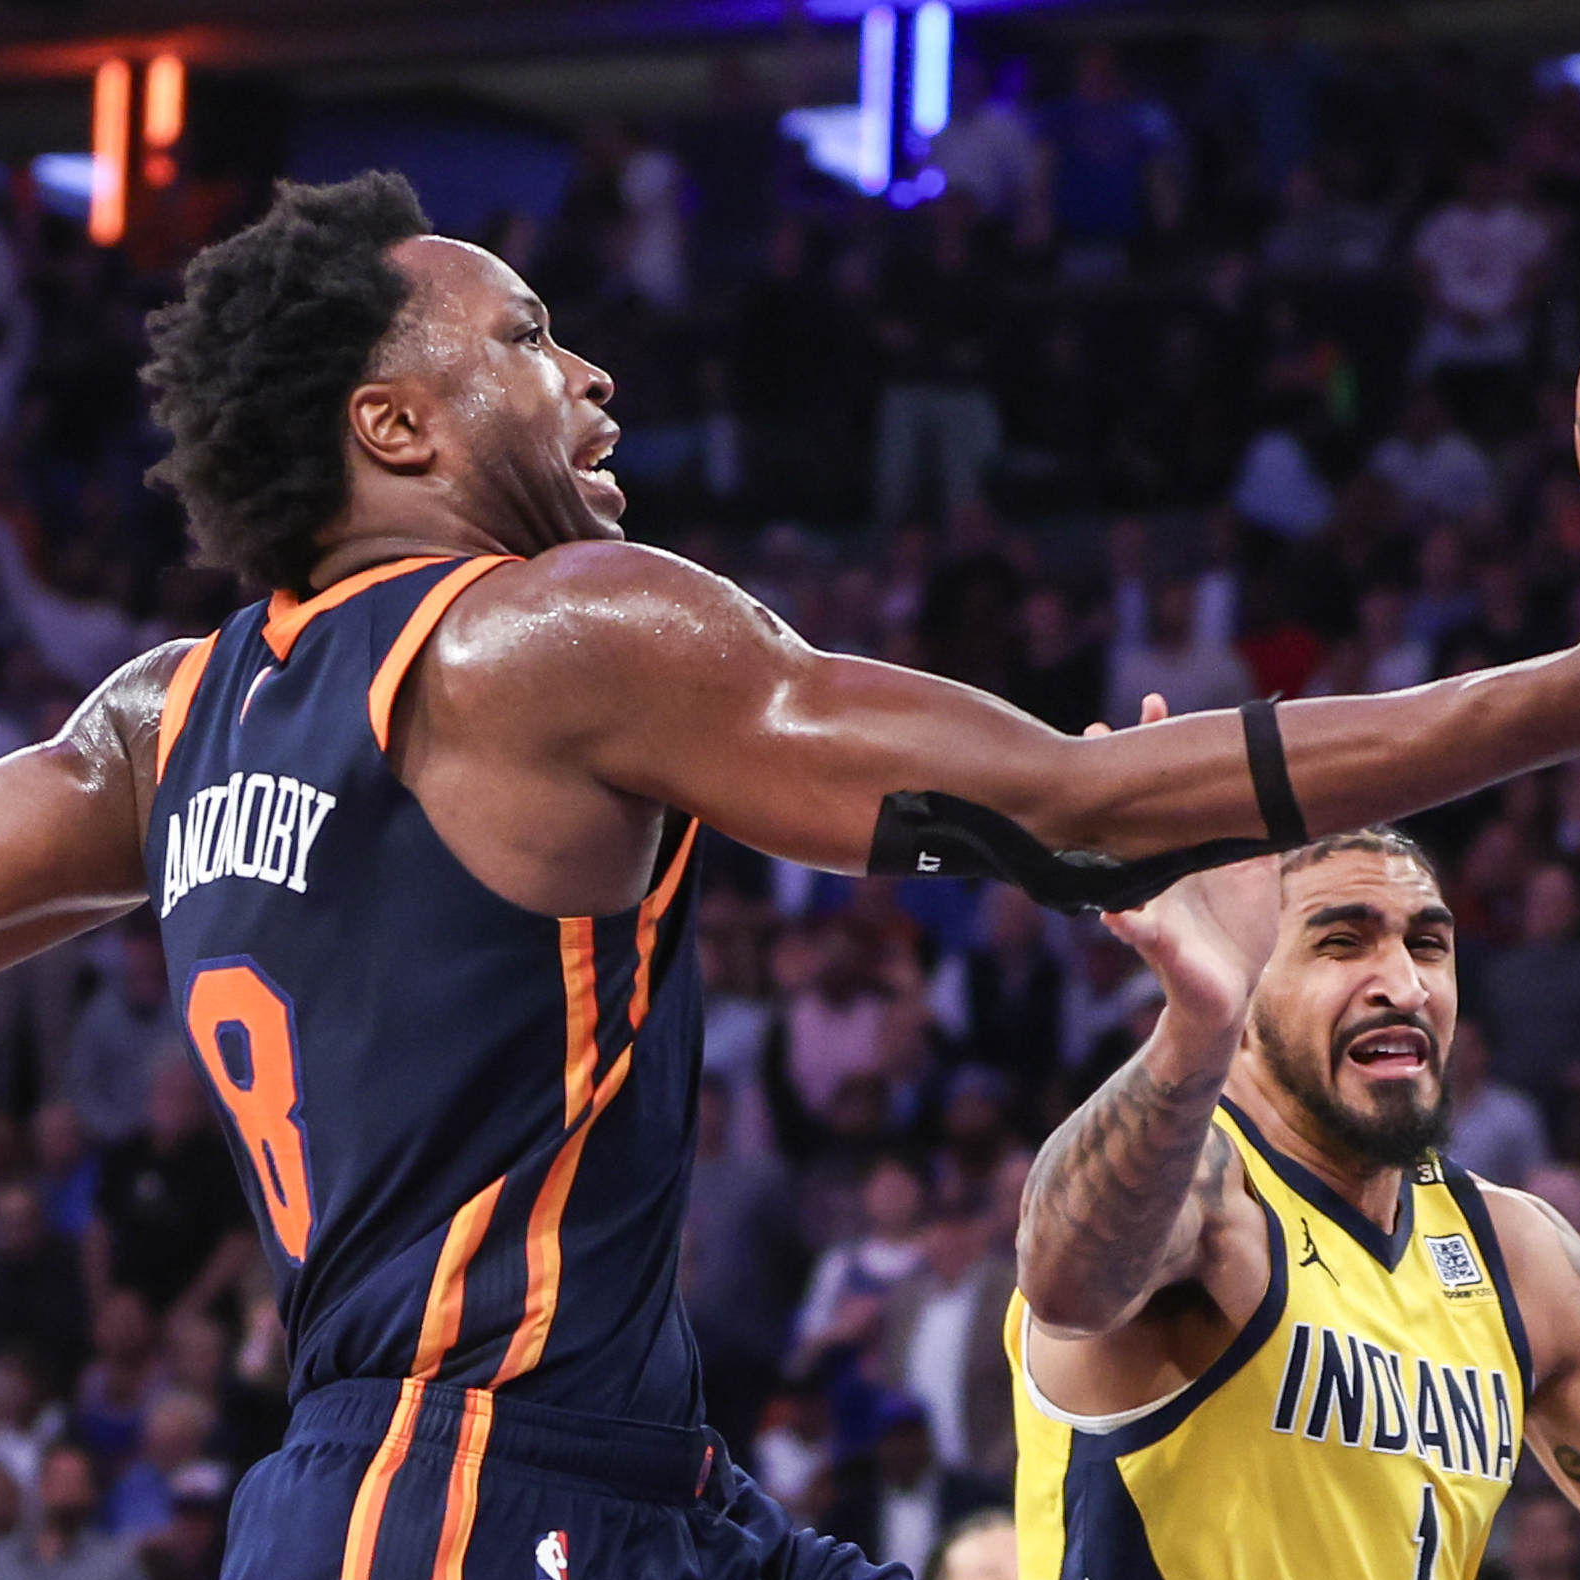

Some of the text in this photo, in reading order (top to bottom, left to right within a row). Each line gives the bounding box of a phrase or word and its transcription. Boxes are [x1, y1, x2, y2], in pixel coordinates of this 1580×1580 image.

[160, 771, 336, 919] ANUNOBY
[182, 953, 319, 1269] 8
[1270, 1321, 1515, 1485] INDIANA
